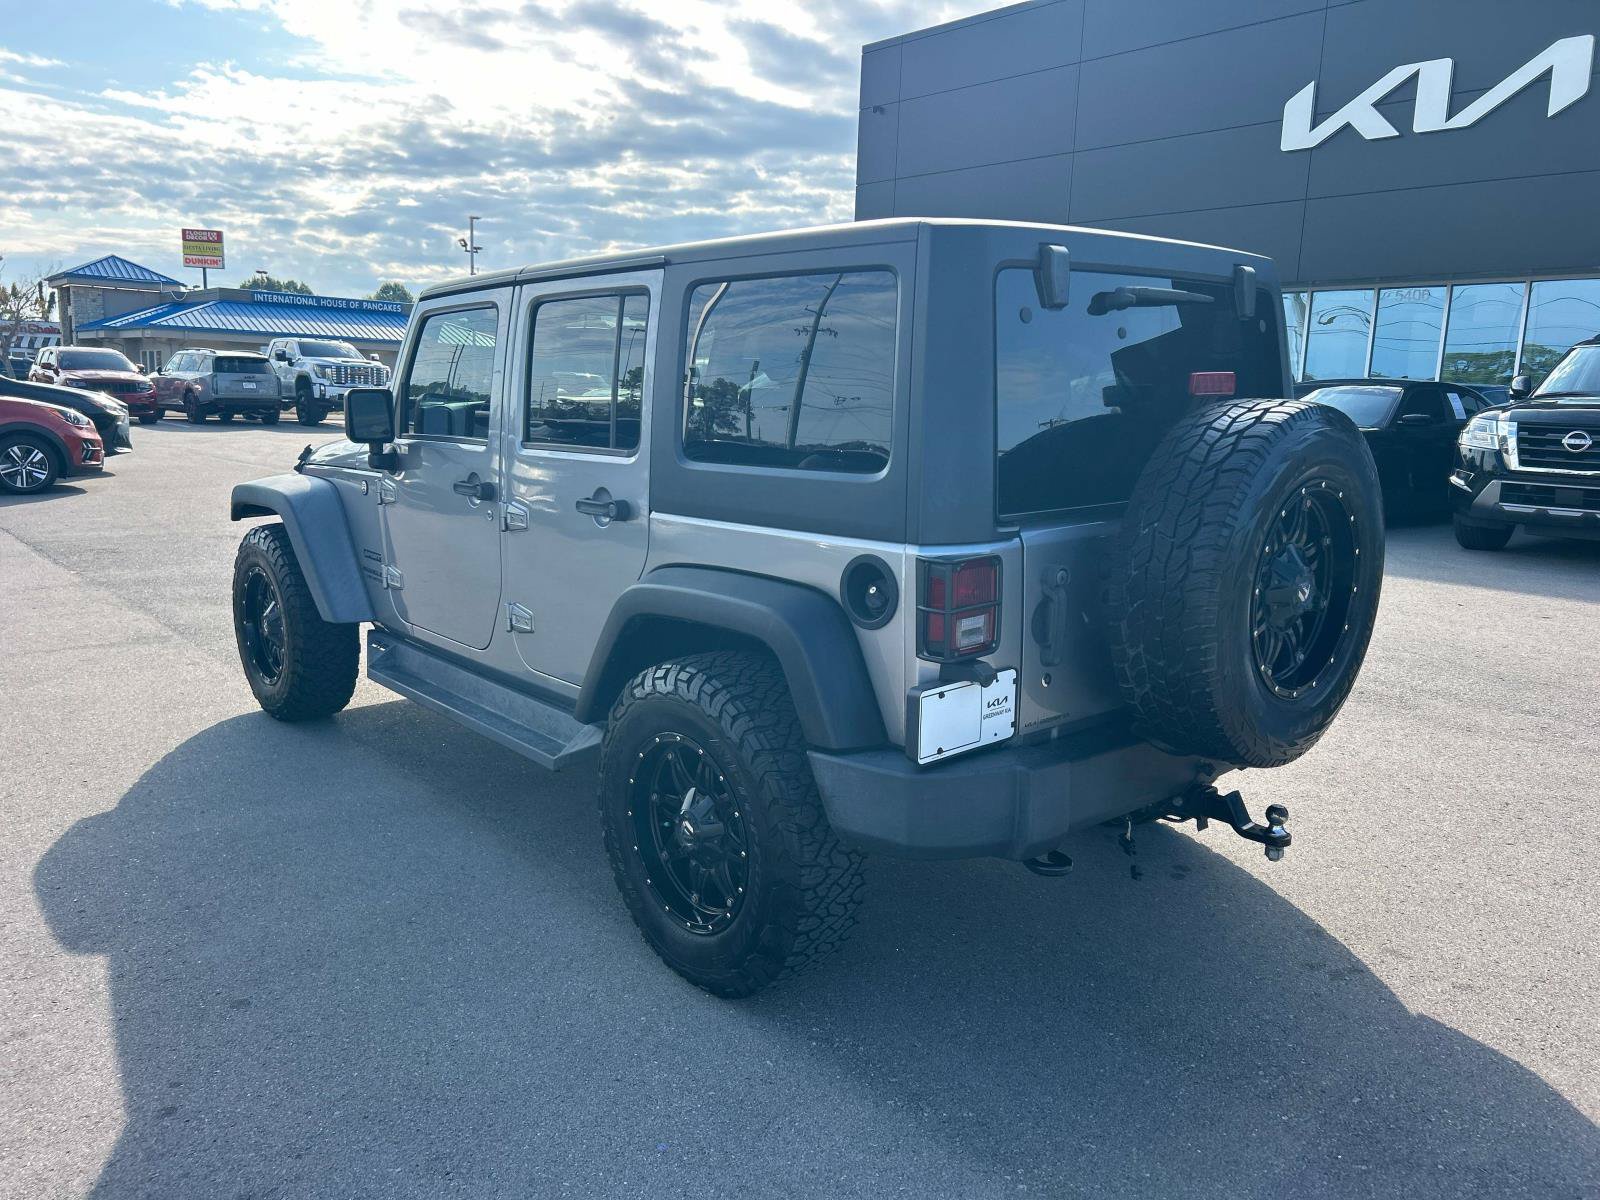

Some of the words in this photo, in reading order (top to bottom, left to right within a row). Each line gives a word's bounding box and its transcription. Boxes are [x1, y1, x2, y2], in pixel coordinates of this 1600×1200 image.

[1280, 34, 1595, 152] KIA
[185, 257, 221, 265] DUNKIN'
[254, 293, 317, 306] INTERNATIONAL
[320, 299, 347, 309] HOUSE
[363, 303, 402, 313] PANCAKES
[987, 695, 1008, 709] KIA
[983, 709, 1005, 720] GREENWAY
